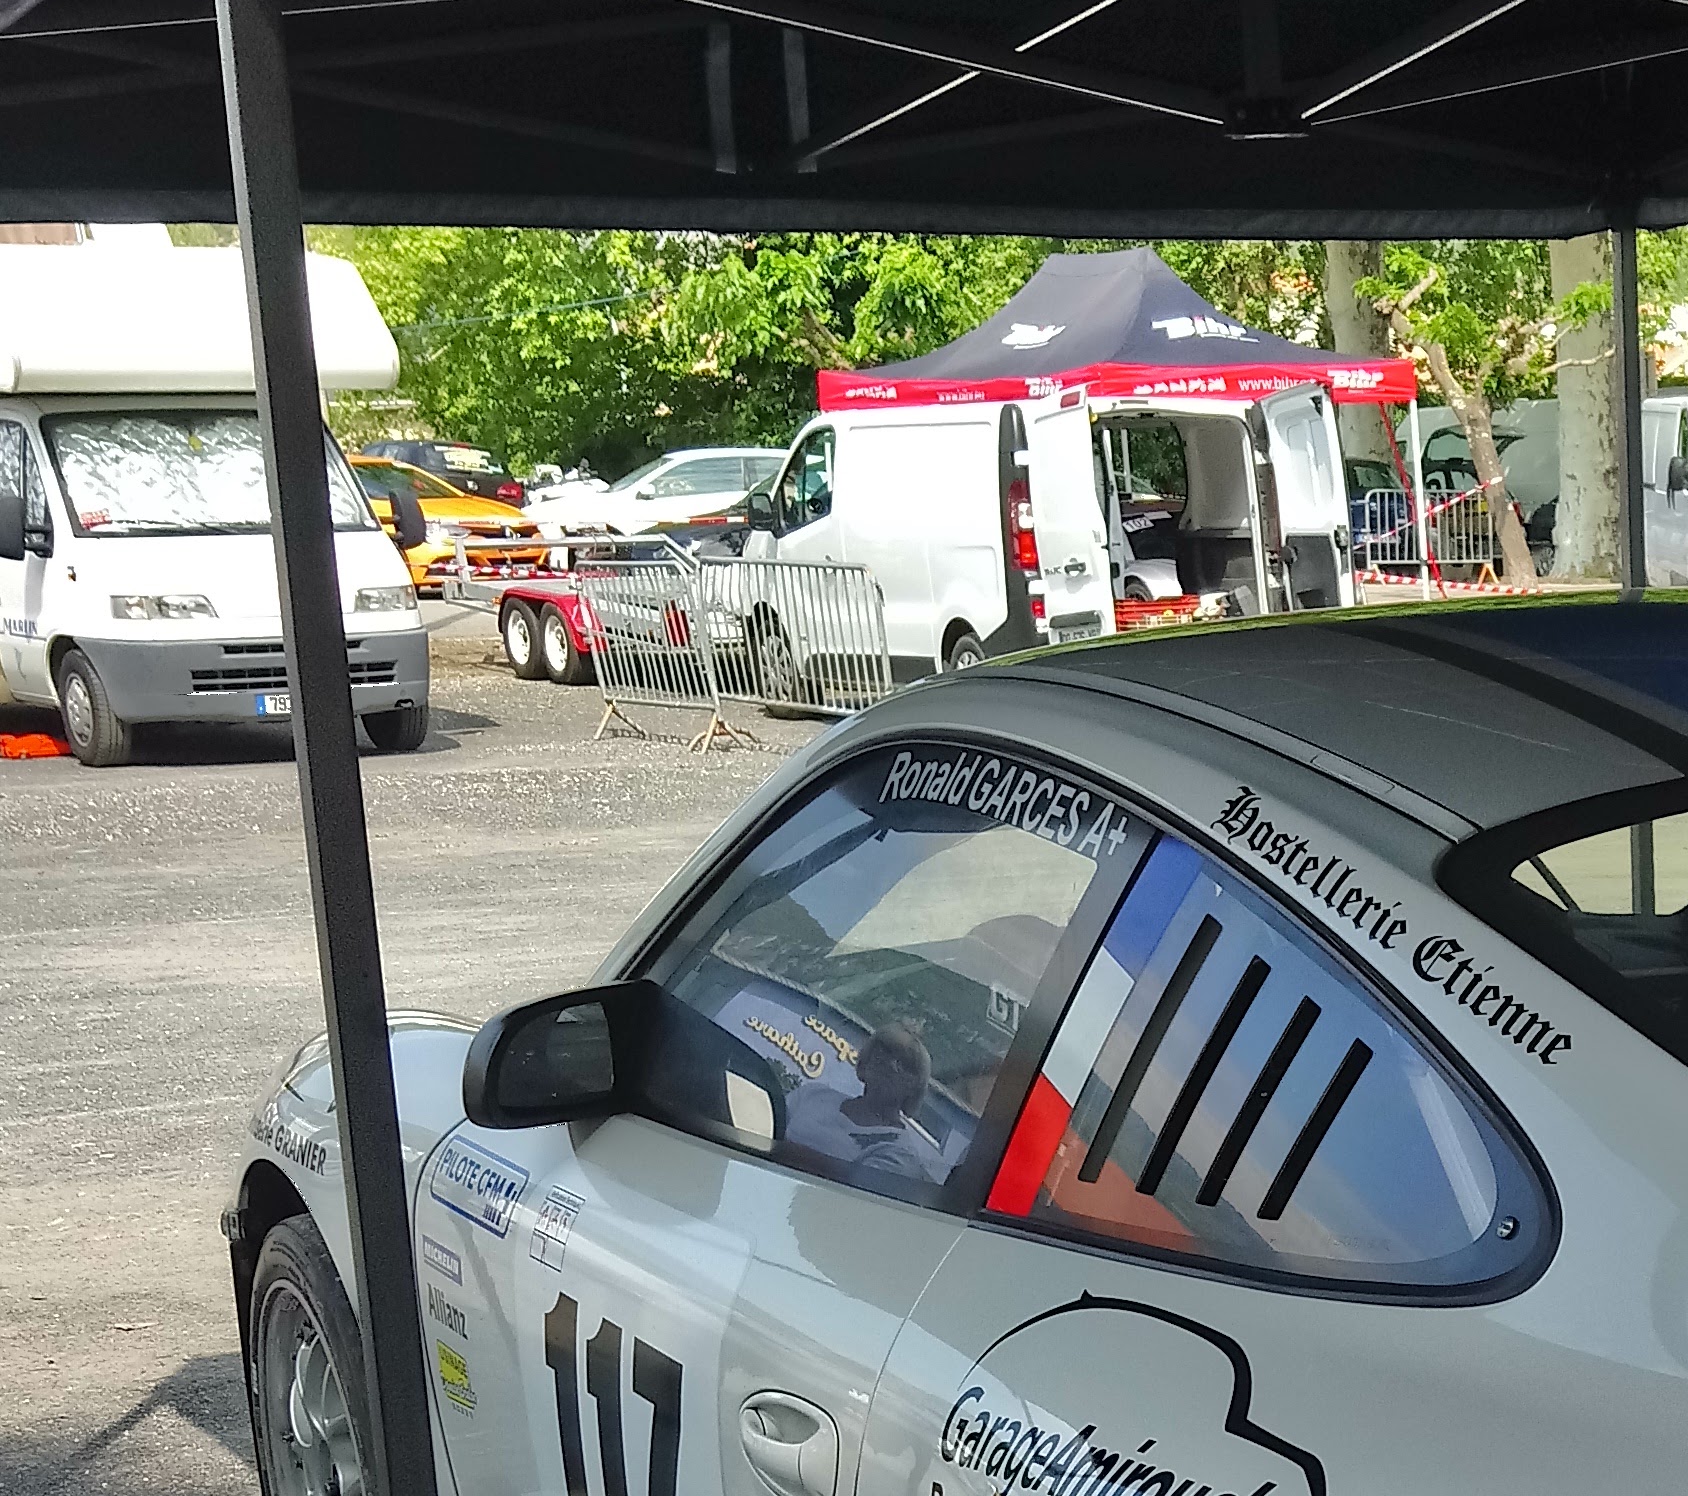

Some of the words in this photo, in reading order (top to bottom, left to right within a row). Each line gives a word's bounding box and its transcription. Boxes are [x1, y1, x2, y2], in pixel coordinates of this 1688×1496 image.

[1125, 518, 1150, 529] 102
[878, 751, 983, 806] Ronald
[967, 757, 1091, 847] GARCES
[1076, 802, 1129, 858] A+
[1210, 786, 1407, 950] Hostellerie
[1412, 935, 1573, 1065] Etienne
[274, 1125, 326, 1176] GRANIER
[438, 1147, 480, 1190] PILOTE
[476, 1168, 506, 1207] CFM
[424, 1240, 459, 1276] MICHELIN
[427, 1282, 469, 1341] Allianz
